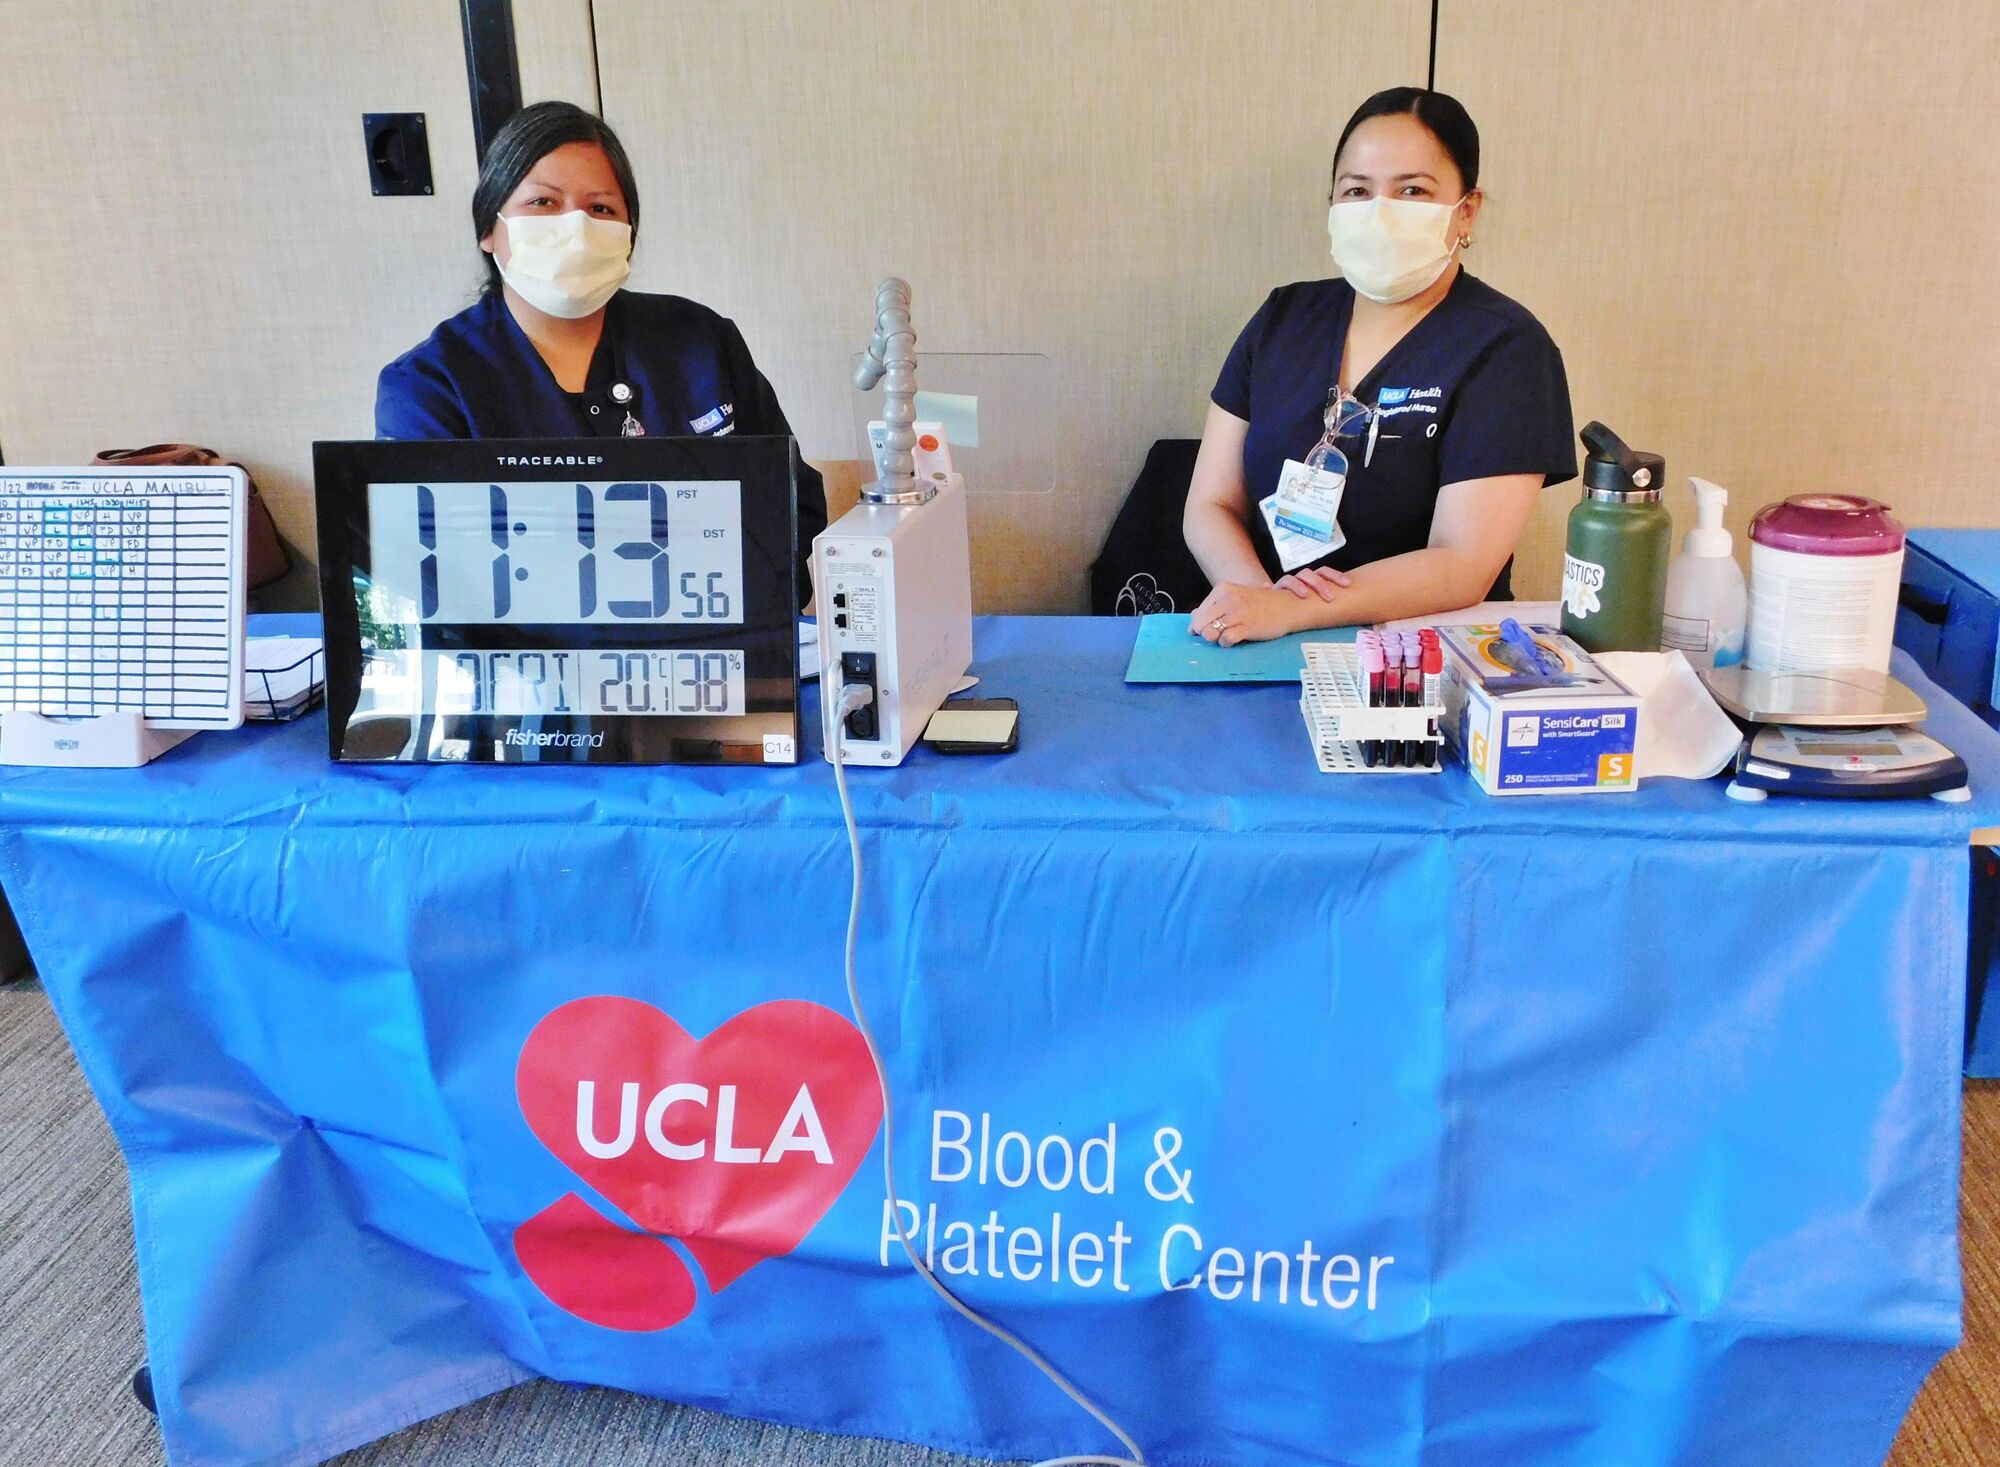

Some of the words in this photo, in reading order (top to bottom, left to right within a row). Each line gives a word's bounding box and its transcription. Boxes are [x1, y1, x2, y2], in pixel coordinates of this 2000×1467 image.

[1382, 391, 1407, 401] UCLA
[1408, 386, 1442, 399] Health
[1411, 403, 1437, 414] Nurse
[92, 481, 134, 495] UCLA
[145, 481, 207, 494] MALIBU
[676, 489, 698, 499] PST
[52, 511, 60, 519] L
[127, 511, 142, 522] VP
[23, 524, 38, 536] VP
[53, 526, 61, 534] L
[126, 524, 142, 536] VP
[703, 529, 725, 539] DST
[24, 537, 38, 549] VP
[78, 538, 87, 547] L
[46, 551, 62, 562] VP
[416, 482, 671, 620] 11:13
[680, 571, 730, 619] 56
[1604, 716, 1622, 726] Silk
[505, 729, 605, 748] fisherbrand
[1542, 730, 1558, 738] with
[764, 741, 792, 754] C14
[1475, 739, 1484, 767] S
[1607, 756, 1624, 777] S
[1504, 774, 1524, 784] 250
[576, 1080, 835, 1165] UCLA
[930, 1109, 1117, 1195] Blood
[1144, 1126, 1195, 1204] &
[879, 1198, 1132, 1292] Platelet
[1158, 1223, 1395, 1311] Center
